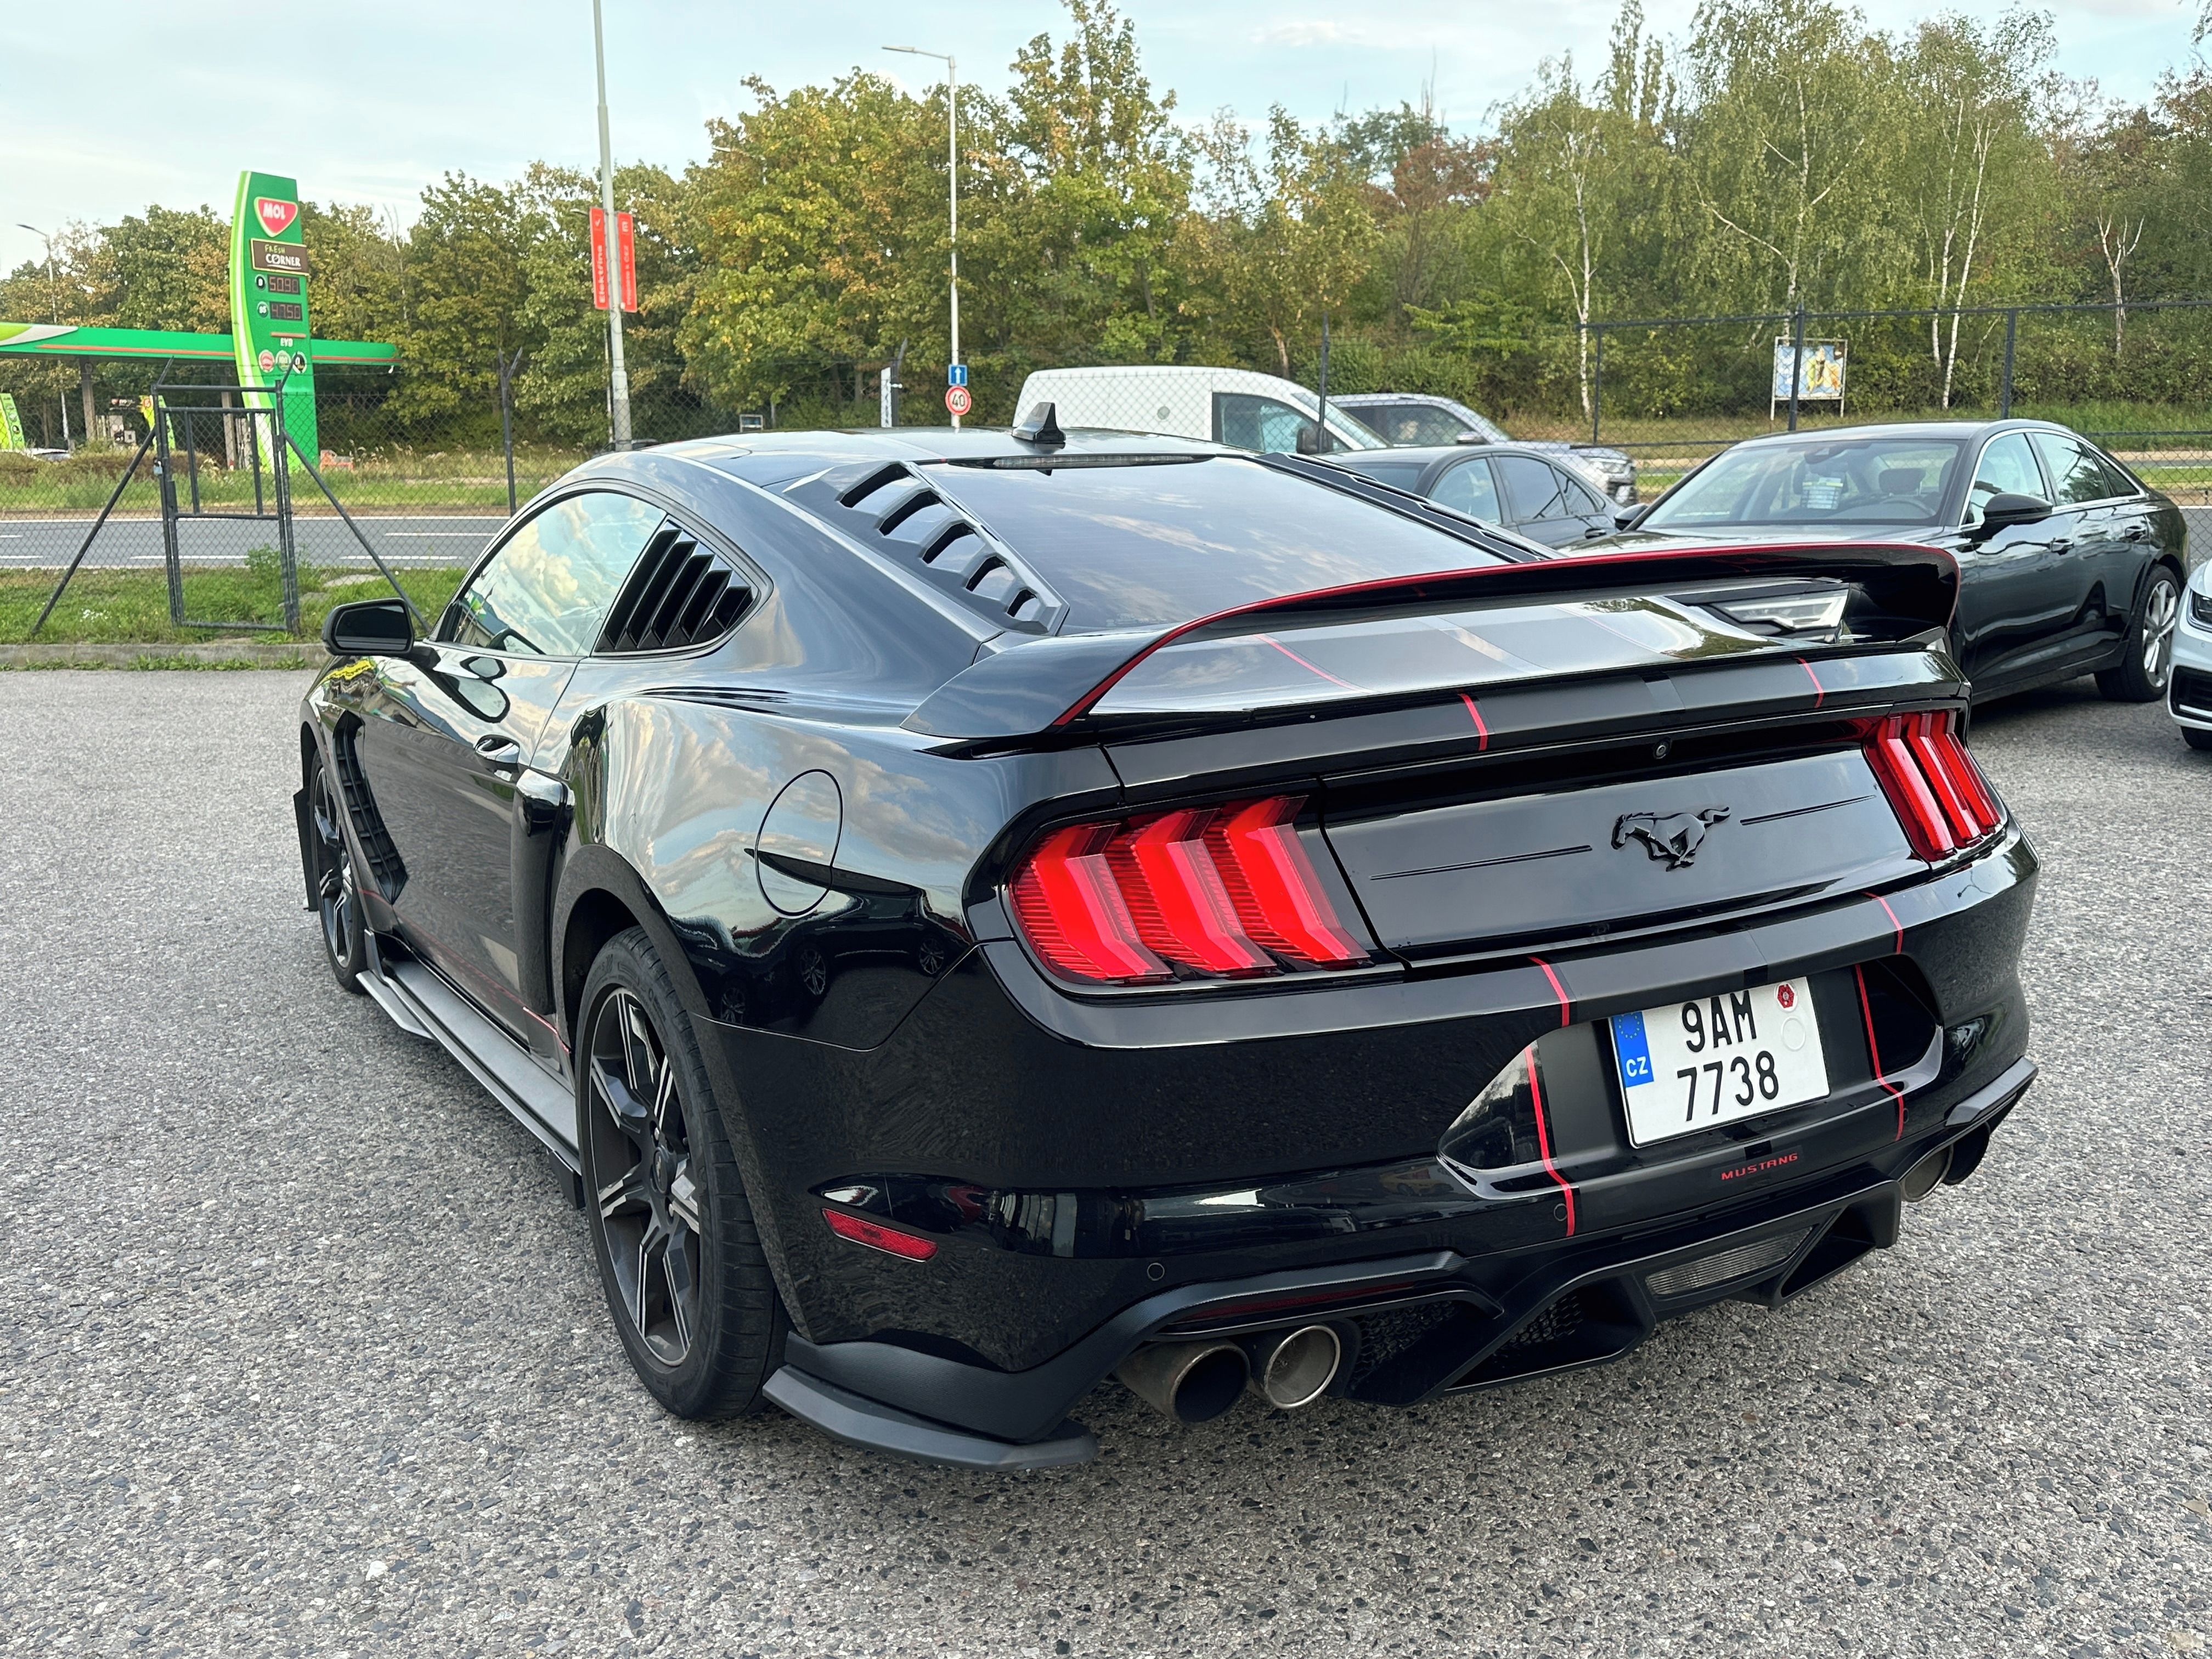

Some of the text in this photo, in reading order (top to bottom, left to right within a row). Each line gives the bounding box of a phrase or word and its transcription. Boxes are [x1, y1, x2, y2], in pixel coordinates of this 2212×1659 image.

[263, 202, 285, 219] MOL
[265, 244, 285, 253] FRESH
[266, 253, 301, 267] CORNER
[952, 394, 966, 407] 40
[1681, 990, 1757, 1052] 9AM
[1626, 1057, 1648, 1077] CZ
[1677, 1051, 1779, 1121] 7738
[1720, 1153, 1798, 1181] MUSTANG
